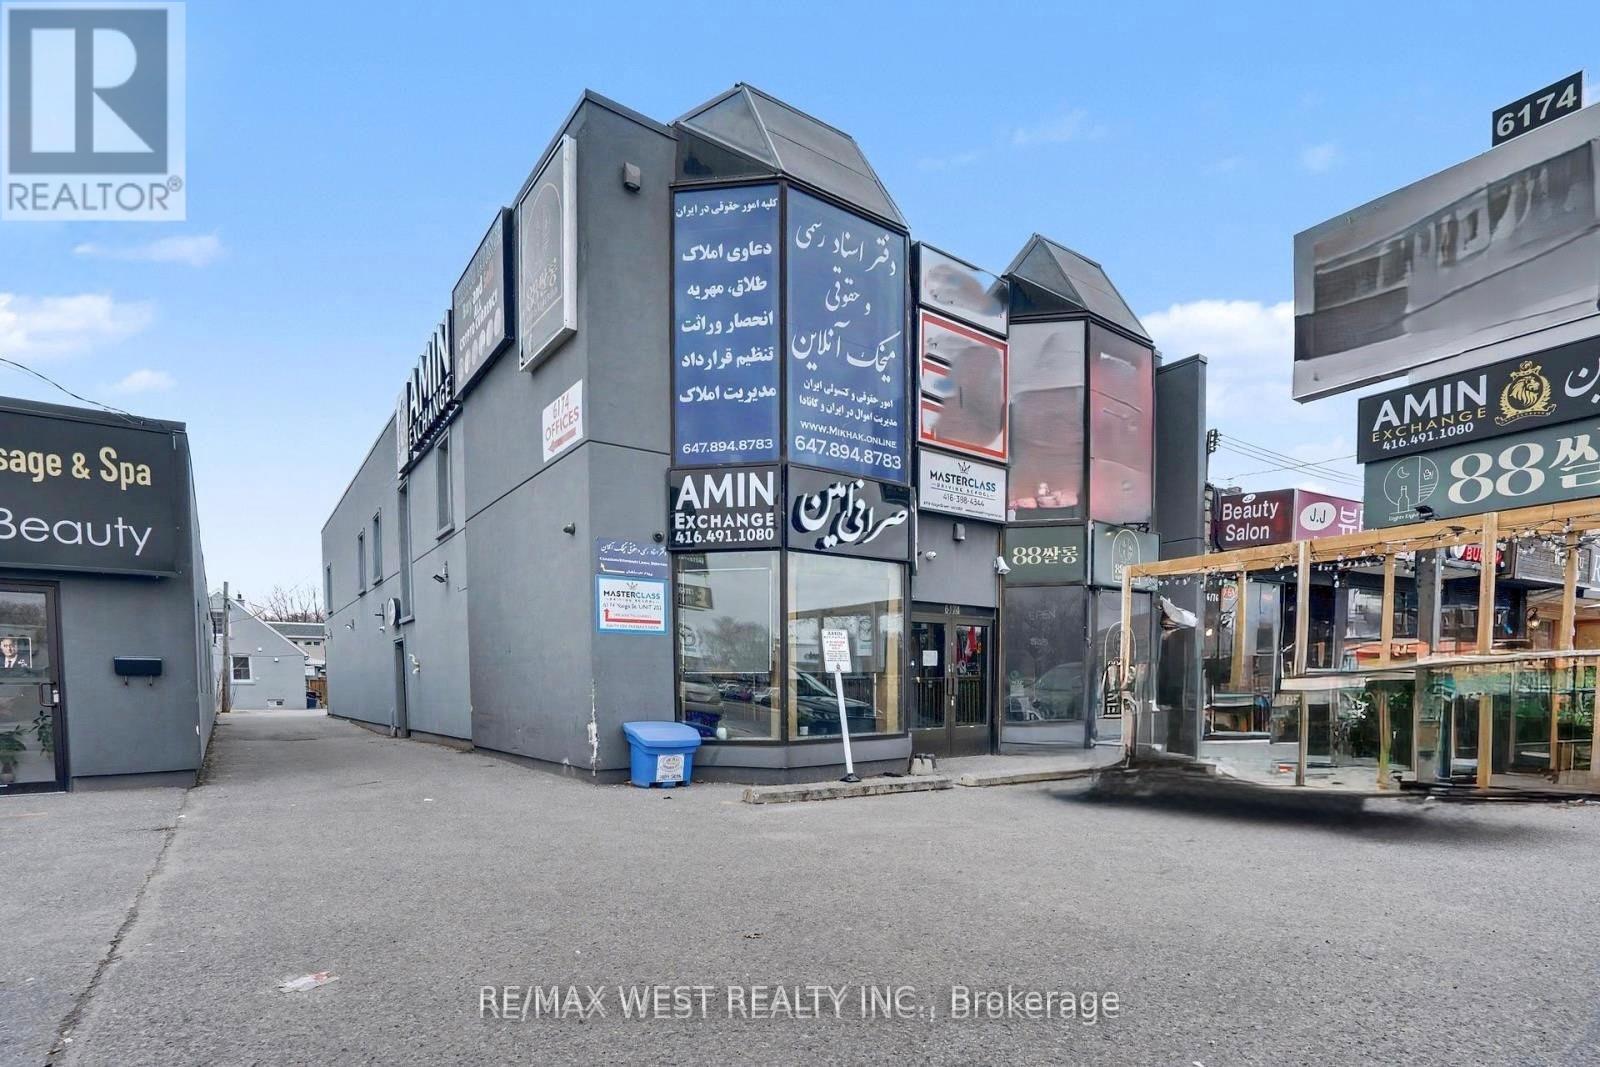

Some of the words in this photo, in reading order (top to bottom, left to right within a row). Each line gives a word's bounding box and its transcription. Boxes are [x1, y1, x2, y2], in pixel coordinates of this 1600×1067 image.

[1497, 83, 1577, 137] 6174
[675, 204, 697, 217] ایران
[700, 205, 709, 216] در
[711, 201, 740, 215] حقوقی
[741, 200, 760, 212] امور
[795, 222, 826, 249] رسمی
[833, 231, 864, 262] اسناد
[682, 243, 723, 261] املاک
[727, 241, 772, 262] دعاوی
[865, 234, 896, 276] دفتر
[687, 284, 724, 300] مهریه
[825, 265, 860, 312] حقوقی
[681, 314, 722, 335] وراثت
[726, 310, 773, 333] انحصار
[791, 320, 850, 371] آنلاین
[846, 330, 901, 383] میخک
[681, 348, 733, 370] قرارداد
[736, 346, 774, 368] تنظیم
[409, 309, 452, 428] AMIN
[680, 385, 720, 402] املاک
[724, 385, 777, 403] مدیریت
[803, 378, 823, 392] ایران
[409, 375, 453, 451] EXCHANGE
[553, 392, 569, 419] 6174
[826, 402, 844, 416] ایران
[1373, 374, 1487, 432] AMIN
[545, 406, 579, 441] OFFICES
[1372, 407, 1486, 442] EXCHANGE
[682, 438, 773, 454] 647.894.8783
[1383, 422, 1473, 450] 416.491.1080
[795, 435, 902, 470] 647.894.8783
[72, 452, 91, 479] &
[100, 446, 152, 491] Spa
[675, 471, 774, 510] AMIN
[929, 470, 996, 492] MASTERCLASS
[674, 512, 774, 530] EXCHANGE
[1222, 500, 1279, 522] Beauty
[1309, 507, 1326, 524] J.J
[0, 507, 152, 556] Beauty
[675, 528, 774, 544] 416.491.1080
[1226, 523, 1269, 541] Salon
[1012, 546, 1078, 565] 88쌀롱
[603, 590, 661, 600] MASTERCLASS
